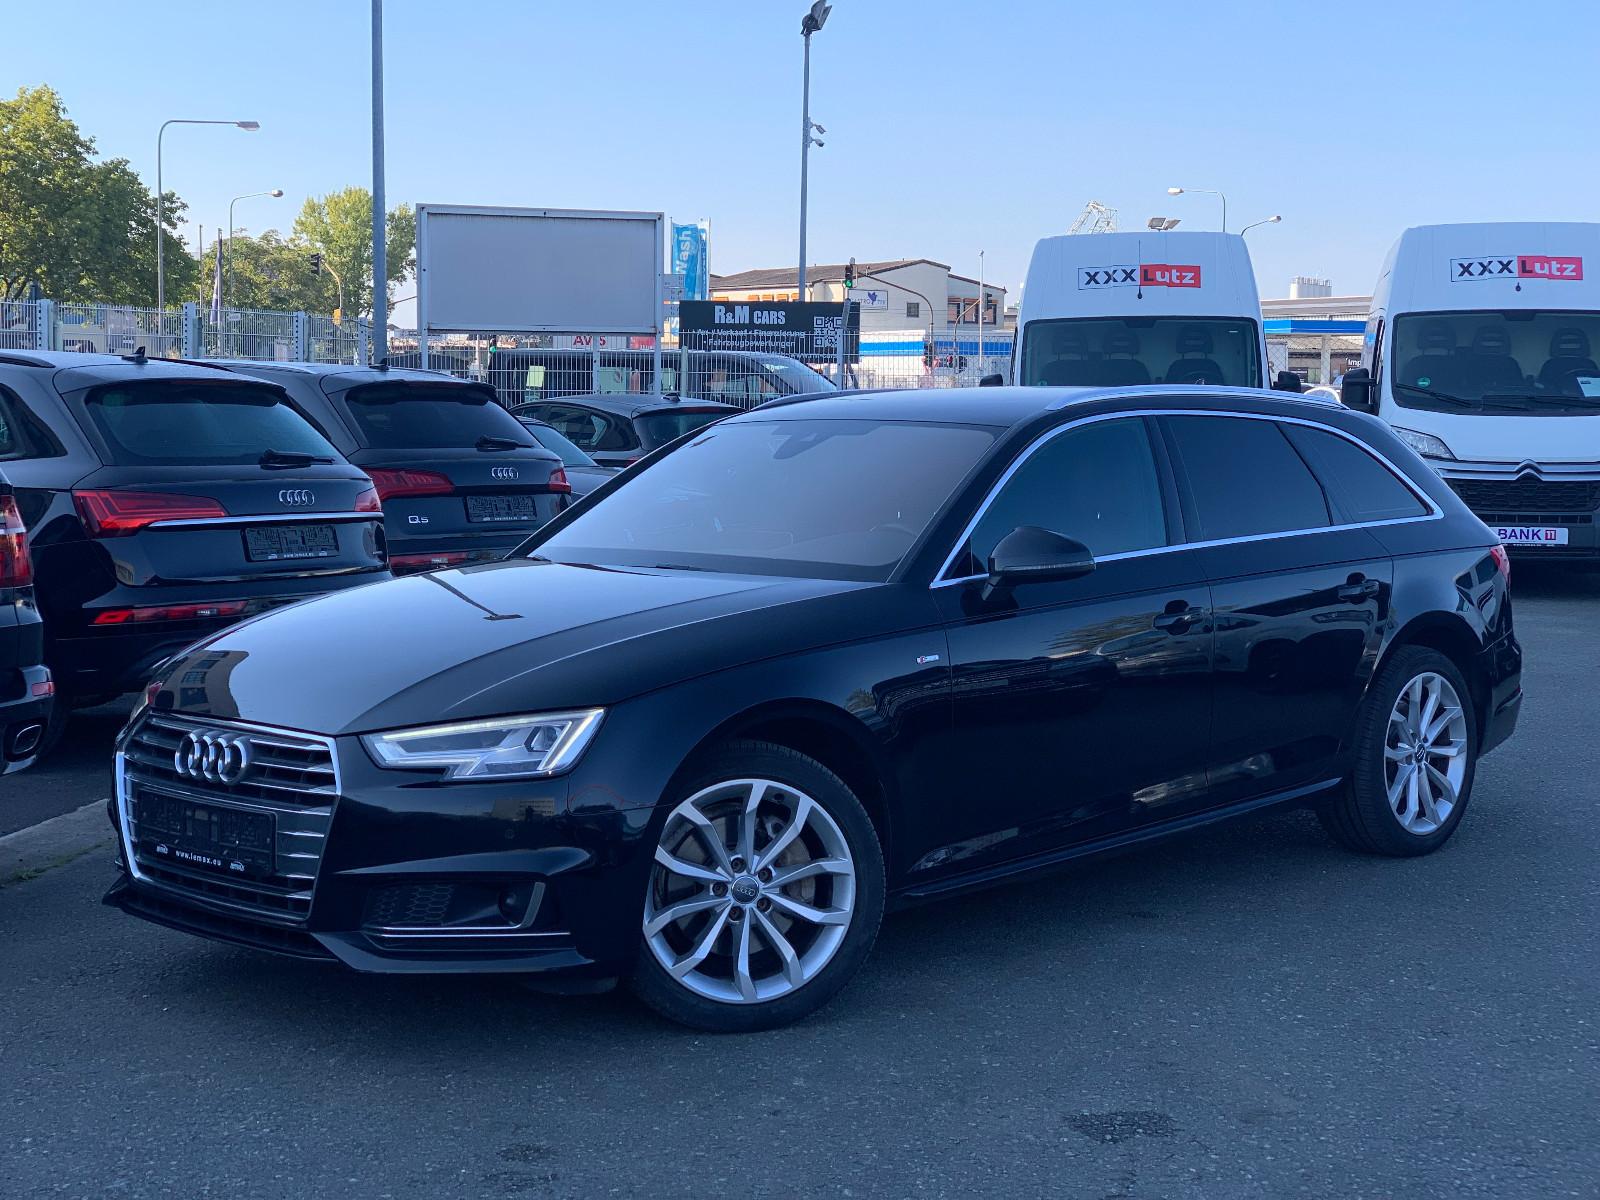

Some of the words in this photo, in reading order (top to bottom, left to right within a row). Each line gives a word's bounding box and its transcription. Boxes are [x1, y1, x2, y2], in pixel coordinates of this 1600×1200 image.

[715, 305, 749, 324] R&M
[753, 311, 786, 325] CARS
[573, 336, 606, 345] AVS
[408, 515, 429, 524] Q5
[1498, 529, 1541, 540] BANK
